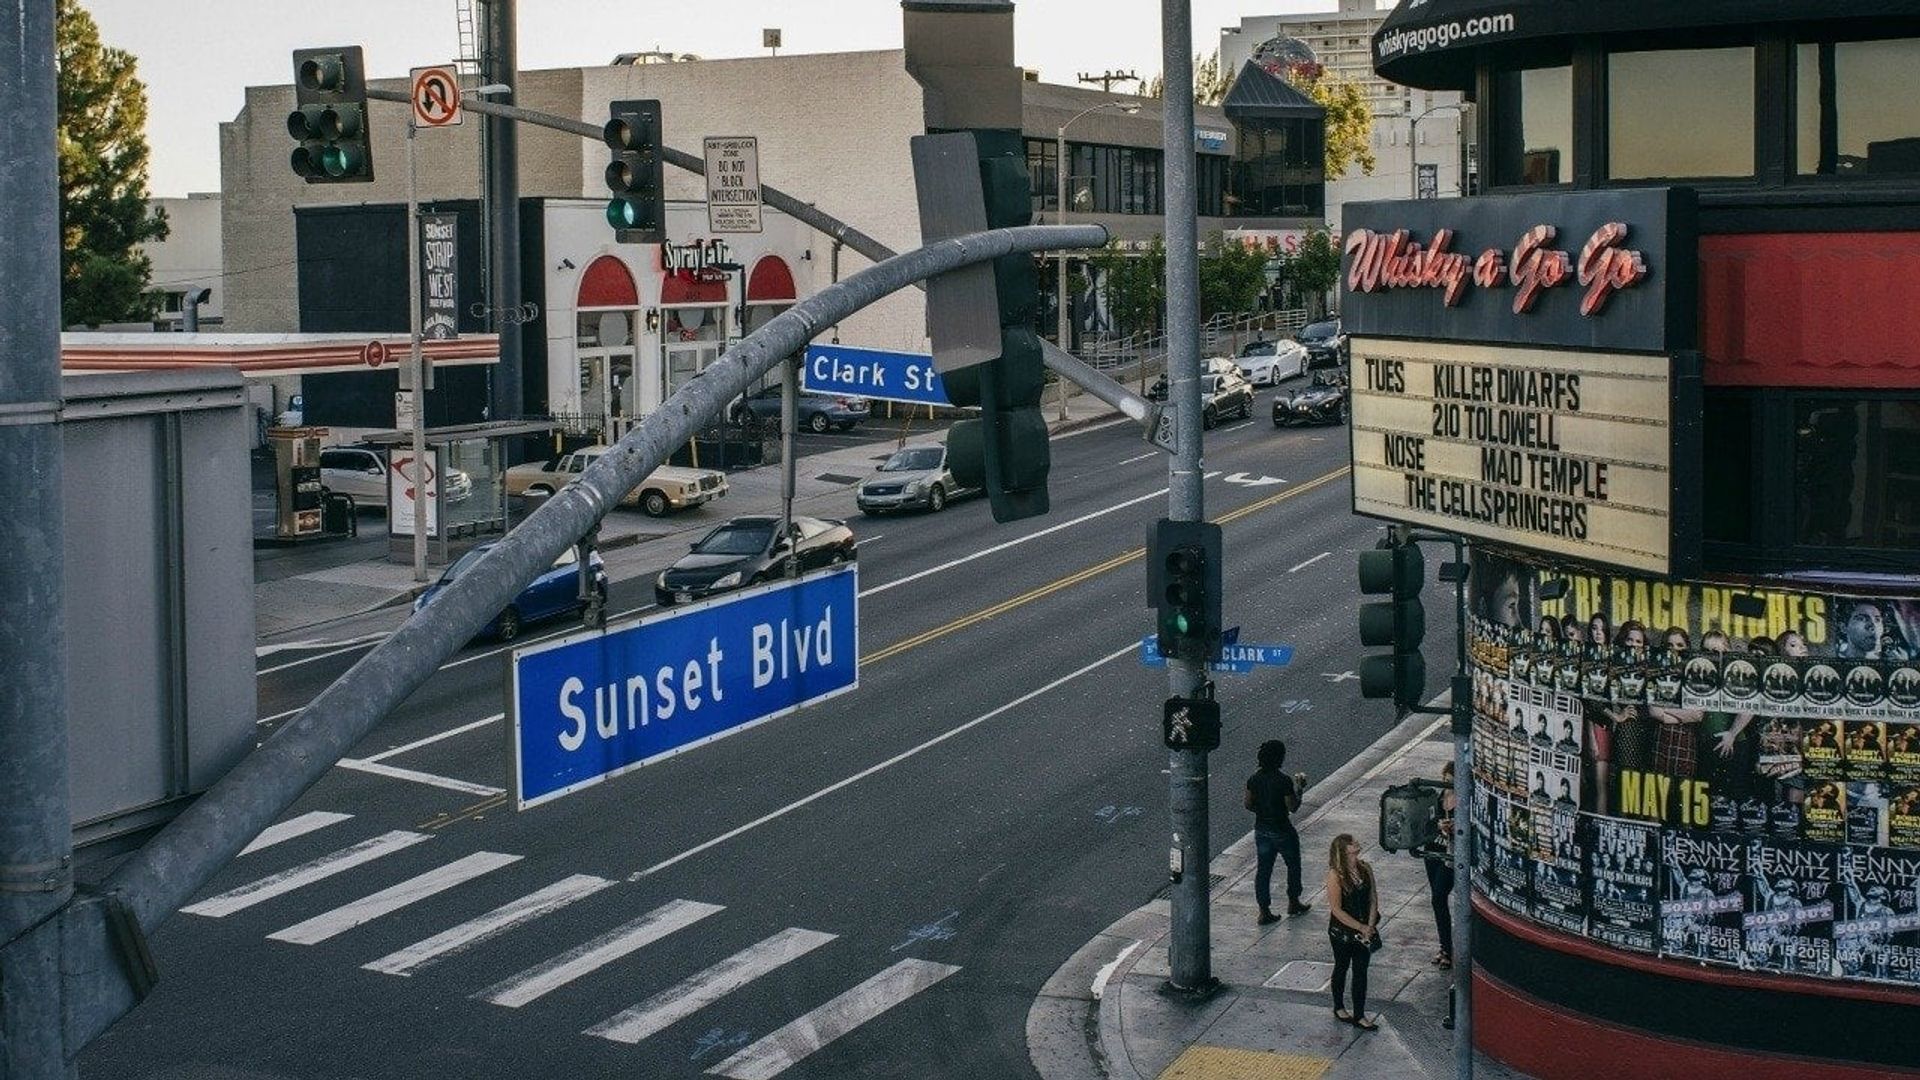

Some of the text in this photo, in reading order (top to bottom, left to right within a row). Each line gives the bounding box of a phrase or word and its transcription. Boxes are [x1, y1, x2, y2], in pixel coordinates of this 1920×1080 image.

[1378, 13, 1514, 56] whiskyagogo.com
[718, 160, 745, 172] DO NOT
[722, 176, 744, 187] BLOCK
[712, 190, 757, 202] INTERSECTION
[426, 223, 454, 239] SUNSET
[426, 241, 453, 270] STRIP
[1346, 228, 1471, 308] Whisky
[1510, 224, 1573, 314] Go
[1578, 222, 1646, 316] Go
[428, 272, 454, 298] WEST
[814, 355, 935, 391] Clark St
[1366, 358, 1580, 411] TUES KILLER DWARFS
[1432, 404, 1460, 437] 210
[1384, 434, 1608, 500] NOSE MAD TEMPLE
[1405, 474, 1588, 540] THE CELLSPRINGERS
[1611, 576, 1689, 630] BACK
[1222, 647, 1264, 662] CLARK
[558, 605, 833, 752] Sunset Blvd
[1622, 770, 1670, 820] MAY
[1680, 780, 1709, 826] 15
[1599, 823, 1646, 843] THE MAIN
[1599, 836, 1646, 860] EVENT
[1662, 836, 1740, 859] LENNY
[1746, 846, 1830, 867] LENNY
[1663, 851, 1740, 872] KRAVITZ
[1746, 860, 1830, 881] KRAVITZ
[1837, 853, 1920, 875] LENNY
[1744, 906, 1832, 926] SOLD OUT
[1835, 920, 1882, 935] SOLD
[1663, 928, 1689, 944] MAY
[1694, 934, 1710, 945] 15
[1711, 936, 1741, 950] 2015
[1746, 940, 1774, 956] MAY
[1780, 944, 1795, 956] 15
[1798, 946, 1830, 960] 2015
[1836, 950, 1920, 970] MAY 15 2015
